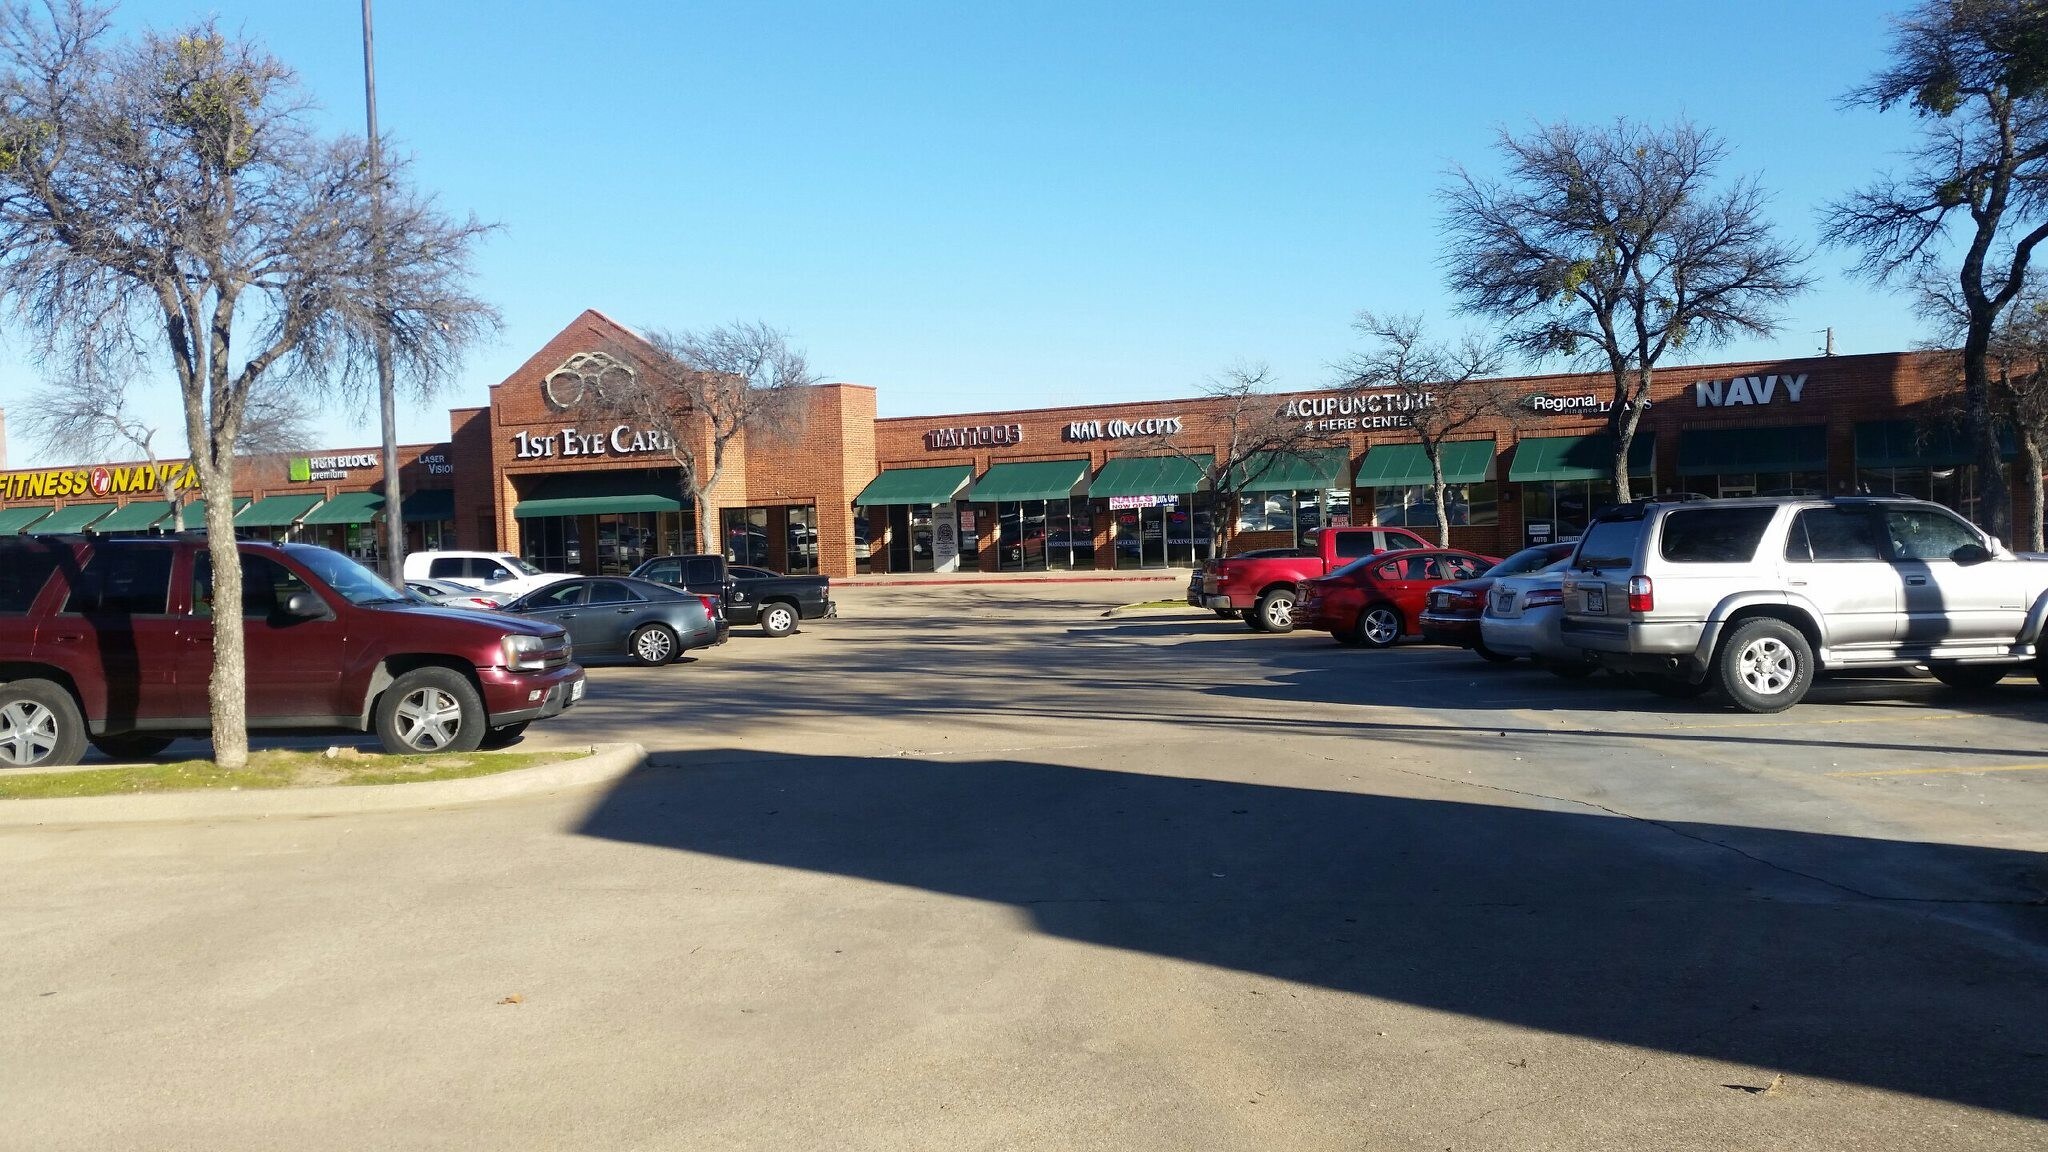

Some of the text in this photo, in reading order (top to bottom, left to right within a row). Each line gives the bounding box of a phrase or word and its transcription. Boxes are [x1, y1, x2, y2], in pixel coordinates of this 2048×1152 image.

[1696, 374, 1809, 408] NAVY
[1286, 392, 1436, 417] ACUPUNCTURE
[1534, 395, 1596, 412] Regional
[1600, 399, 1652, 412] LAS
[1070, 416, 1184, 440] NAIL CONCEPTS
[1304, 415, 1413, 432] & HERB CENTE
[515, 430, 555, 458] 1ST
[561, 428, 605, 455] EYE
[929, 424, 1022, 447] TATTOOS
[310, 454, 378, 470] H&R BLOCK
[418, 455, 445, 464] LASER
[0, 470, 89, 498] FITNESS
[311, 469, 348, 482] premium
